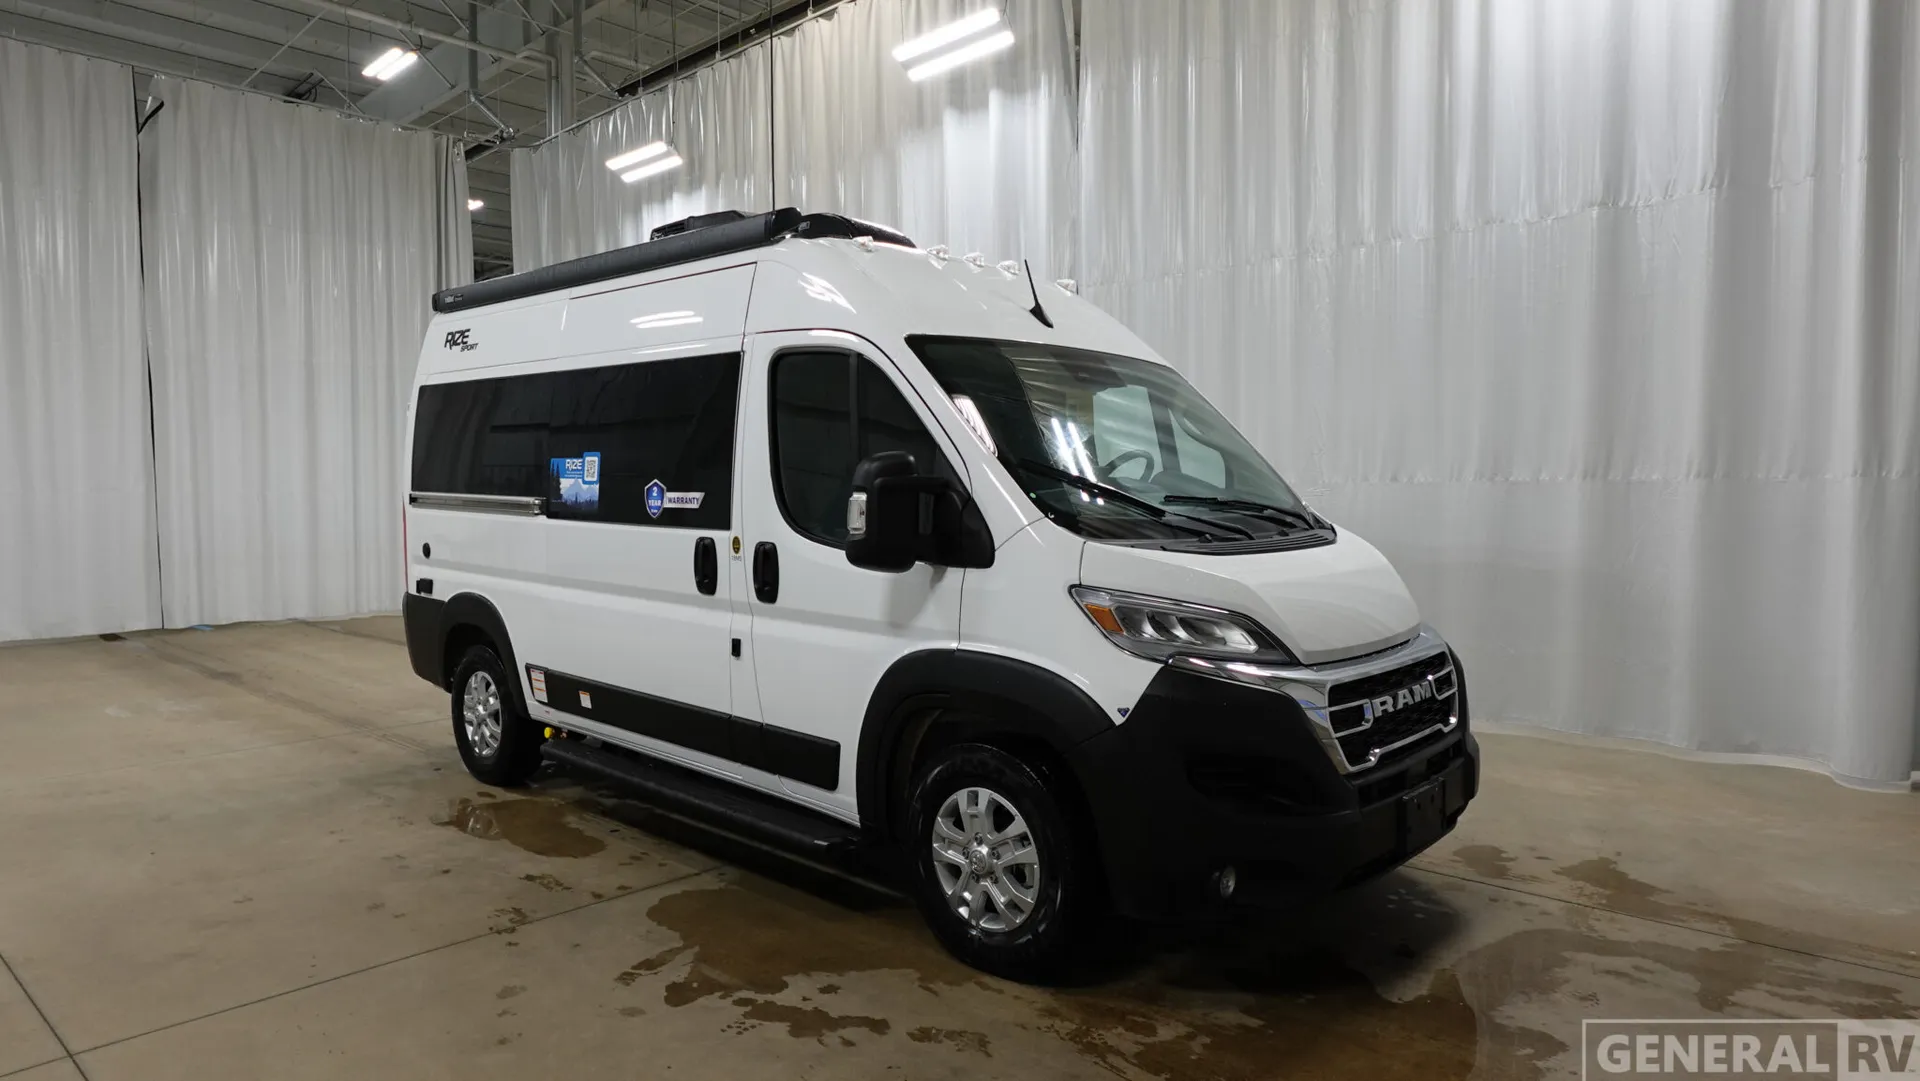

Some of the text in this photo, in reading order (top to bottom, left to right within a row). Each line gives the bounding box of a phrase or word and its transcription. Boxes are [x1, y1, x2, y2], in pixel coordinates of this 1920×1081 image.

[444, 328, 471, 350] RIZE
[460, 342, 479, 352] SPORT
[565, 459, 583, 471] RIZE
[652, 486, 658, 497] 2
[667, 496, 700, 505] WARRANTY
[1371, 680, 1432, 718] RAM
